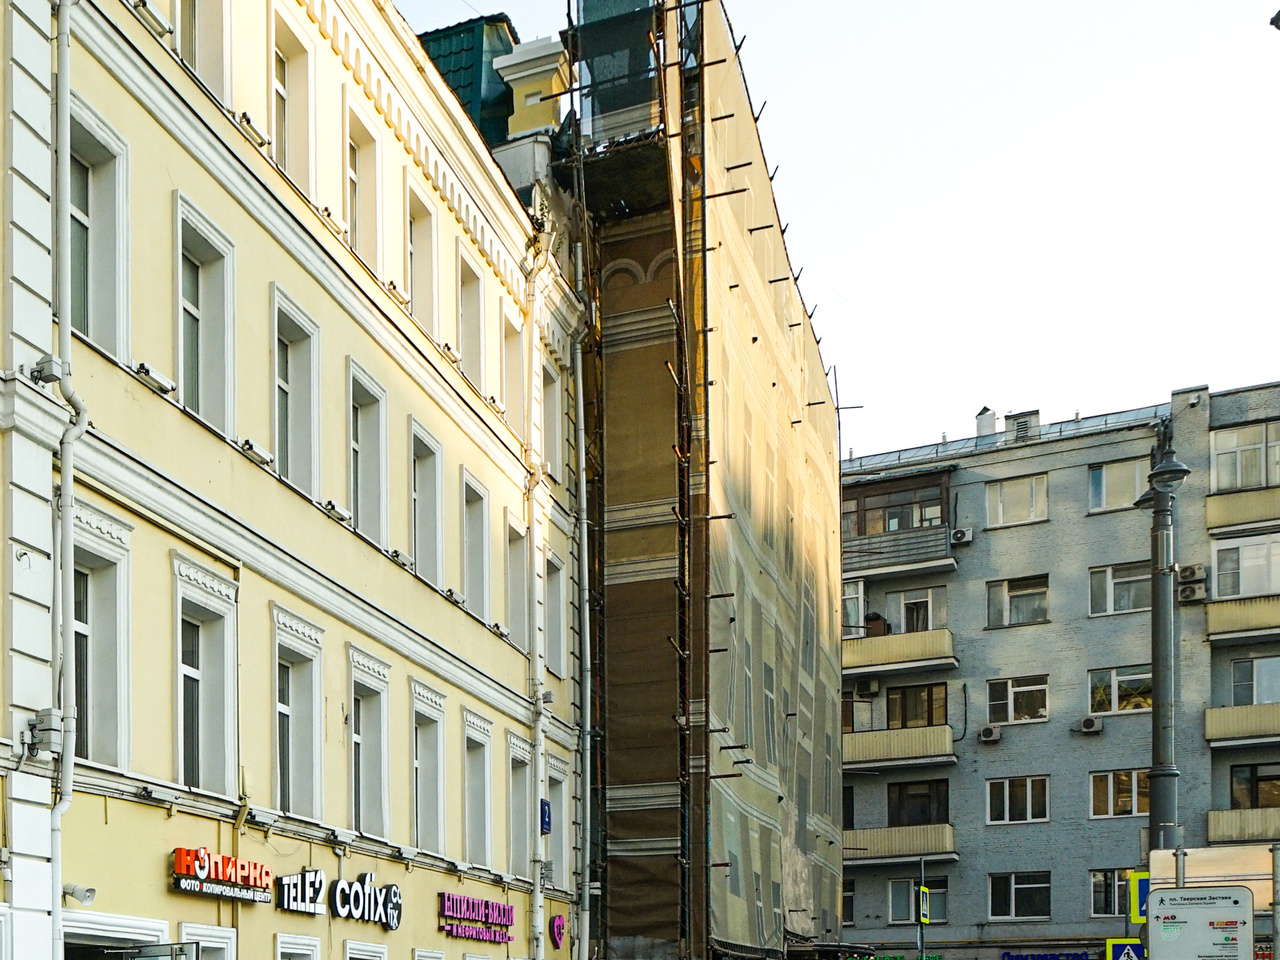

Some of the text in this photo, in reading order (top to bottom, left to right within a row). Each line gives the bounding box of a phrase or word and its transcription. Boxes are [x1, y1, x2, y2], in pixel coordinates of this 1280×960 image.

[254, 889, 272, 903] ЦЕНТР
[282, 869, 327, 915] TELE2
[335, 872, 387, 924] cofix
